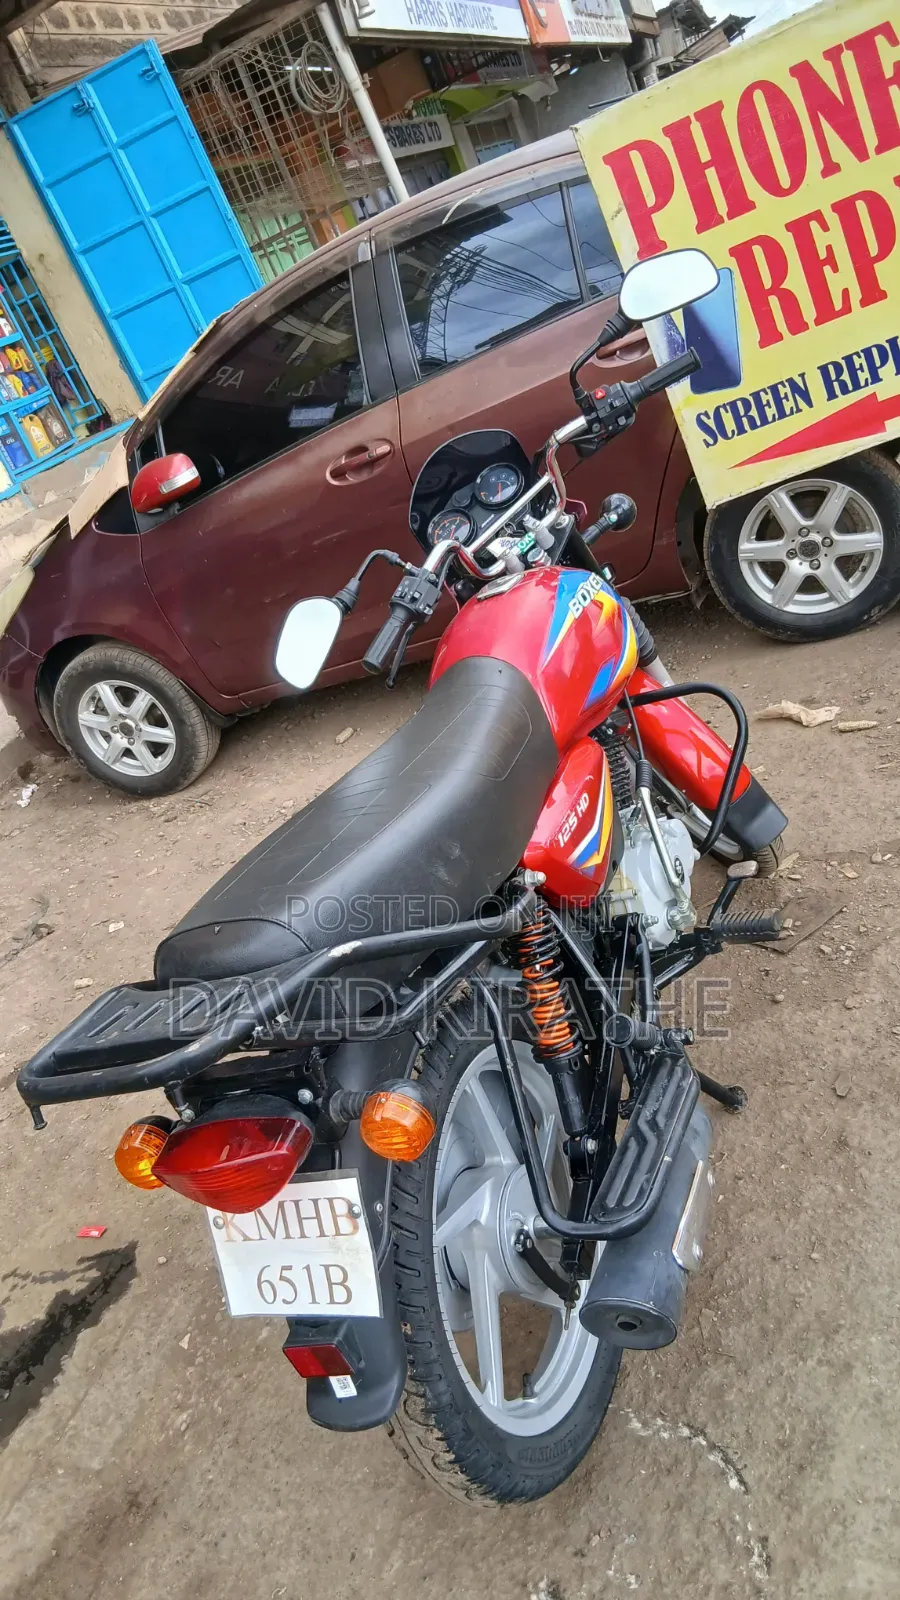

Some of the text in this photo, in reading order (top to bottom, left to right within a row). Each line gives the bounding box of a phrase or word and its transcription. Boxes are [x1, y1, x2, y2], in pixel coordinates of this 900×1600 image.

[404, 0, 498, 30] HARRIS HARDWARE
[388, 123, 426, 148] SPARES
[424, 121, 442, 143] LTD
[728, 175, 900, 349] REP
[695, 372, 814, 449] SCREEN
[557, 792, 590, 848] 125 HD
[221, 1196, 360, 1243] KMHB
[256, 1263, 354, 1306] 651B
